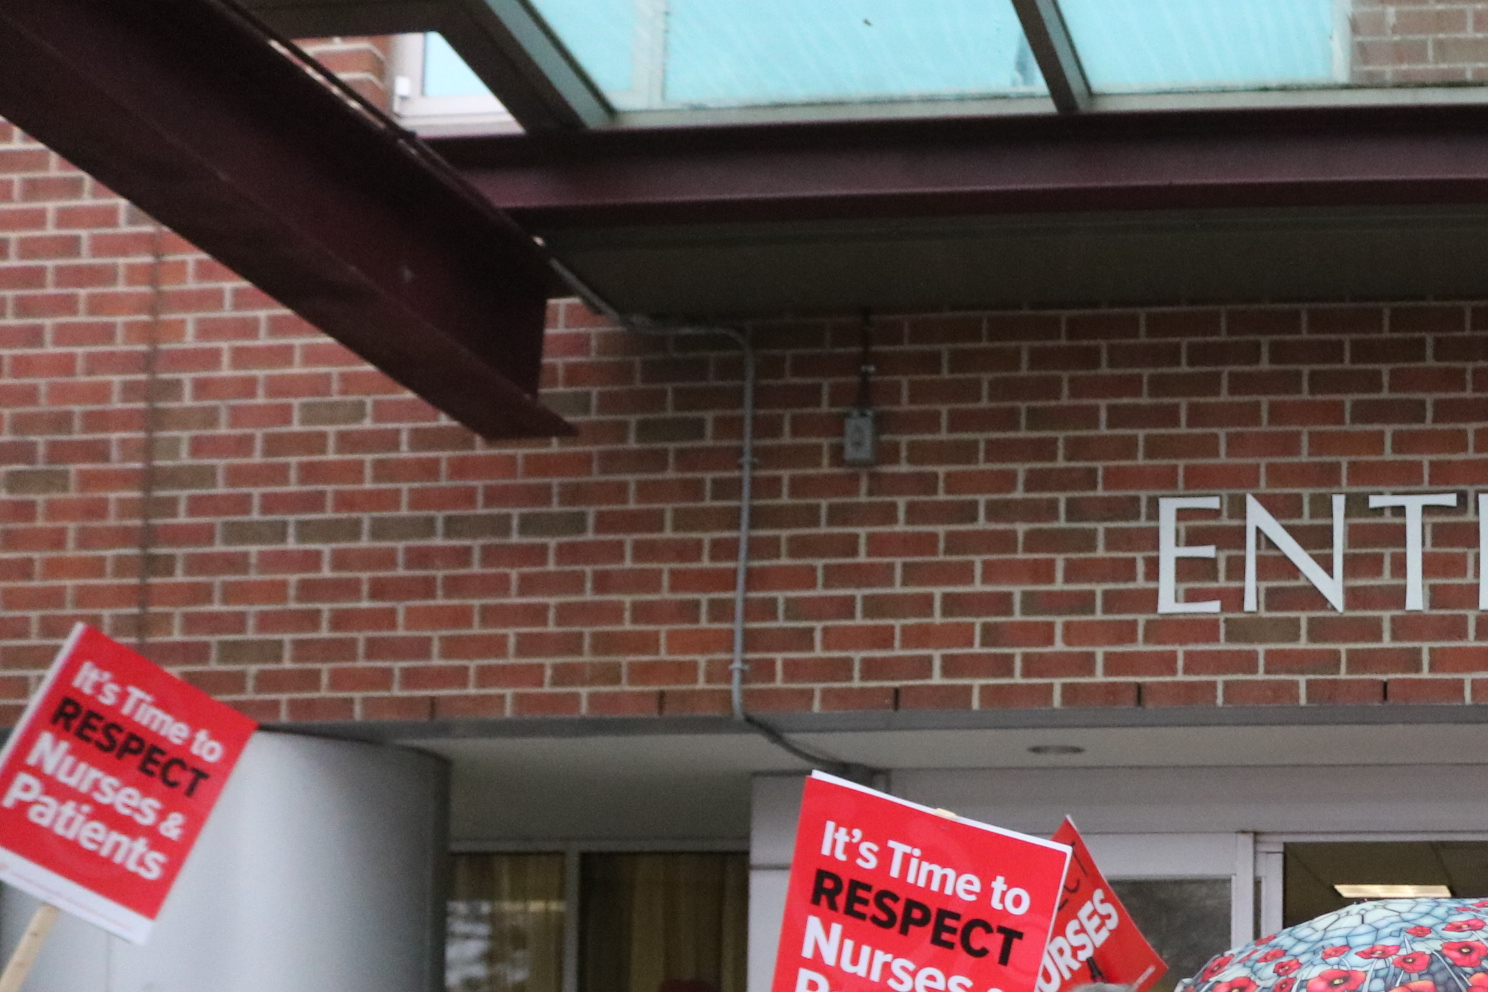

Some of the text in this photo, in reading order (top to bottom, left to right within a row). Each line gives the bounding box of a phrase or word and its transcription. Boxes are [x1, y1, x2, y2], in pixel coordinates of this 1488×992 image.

[52, 696, 210, 798] RESPECT
[72, 661, 224, 763] It's Time to
[1, 772, 168, 881] Patients
[26, 731, 186, 842] Nurses &
[810, 867, 1025, 968] RESPECT
[820, 819, 879, 870] It's
[886, 839, 981, 902] Time
[990, 874, 1031, 916] to
